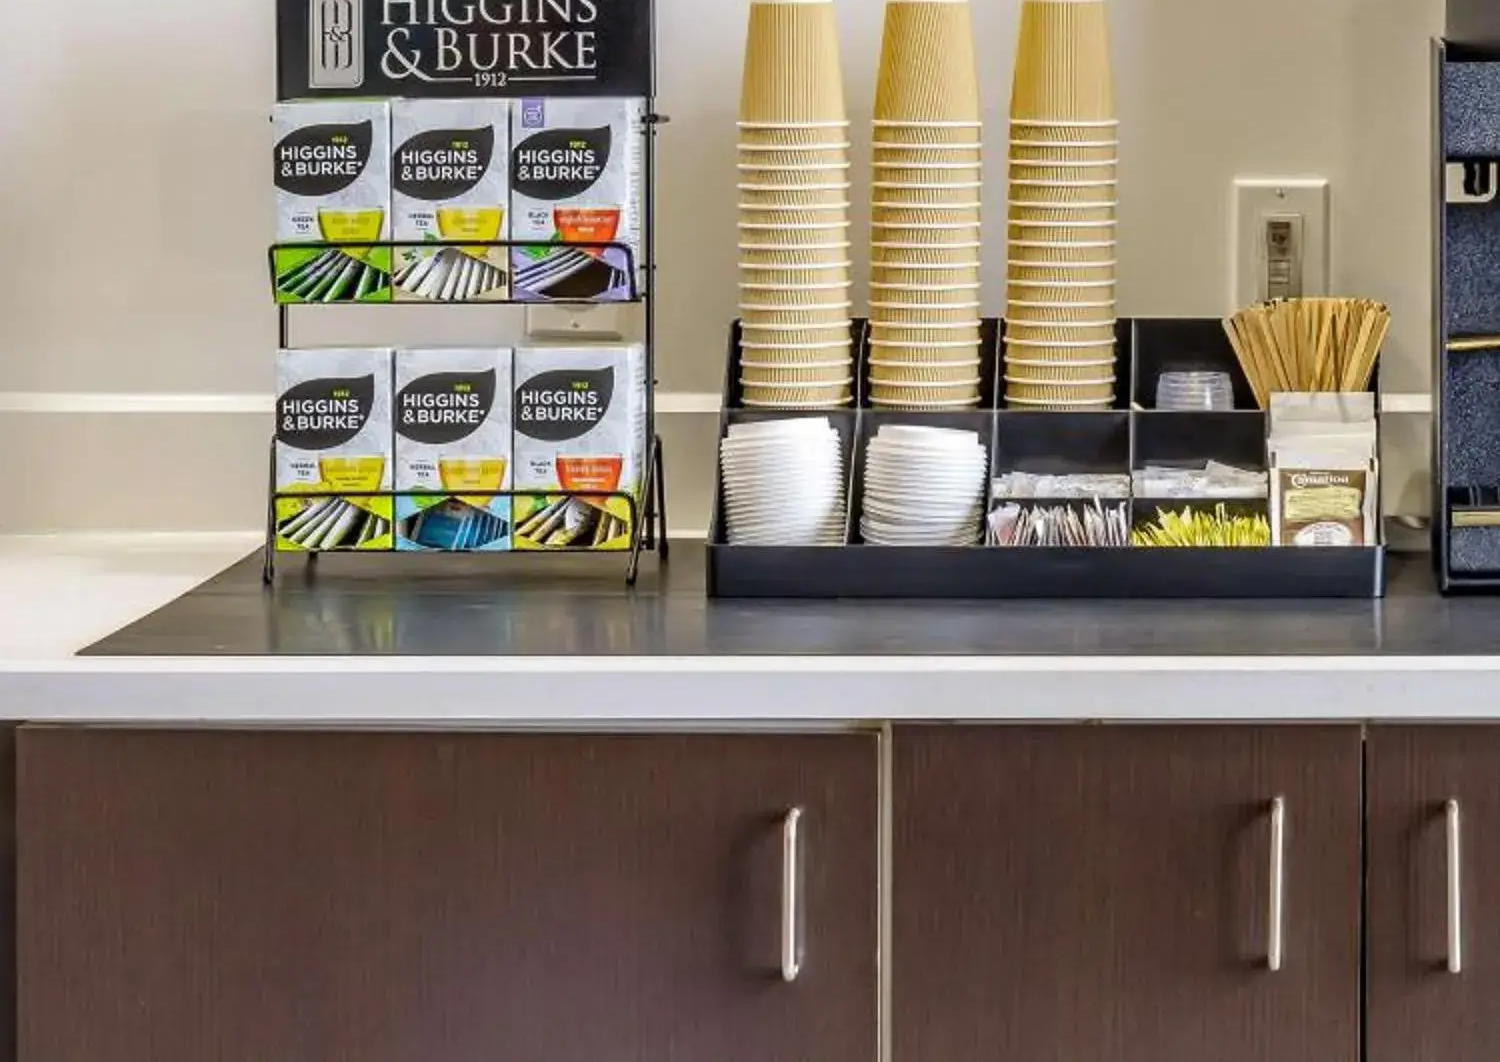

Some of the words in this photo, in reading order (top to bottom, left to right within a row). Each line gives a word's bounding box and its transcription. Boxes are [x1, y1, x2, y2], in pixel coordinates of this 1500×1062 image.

[380, 27, 432, 82] &
[434, 27, 598, 72] BURKE
[474, 72, 509, 87] 1912
[281, 145, 357, 160] HIGGINS
[401, 150, 478, 165] HIGGINS
[518, 149, 595, 164] HIGGINS
[403, 393, 480, 407] HIGGINS
[521, 390, 598, 405] HIGGINS
[283, 399, 360, 414] HIGGINS
